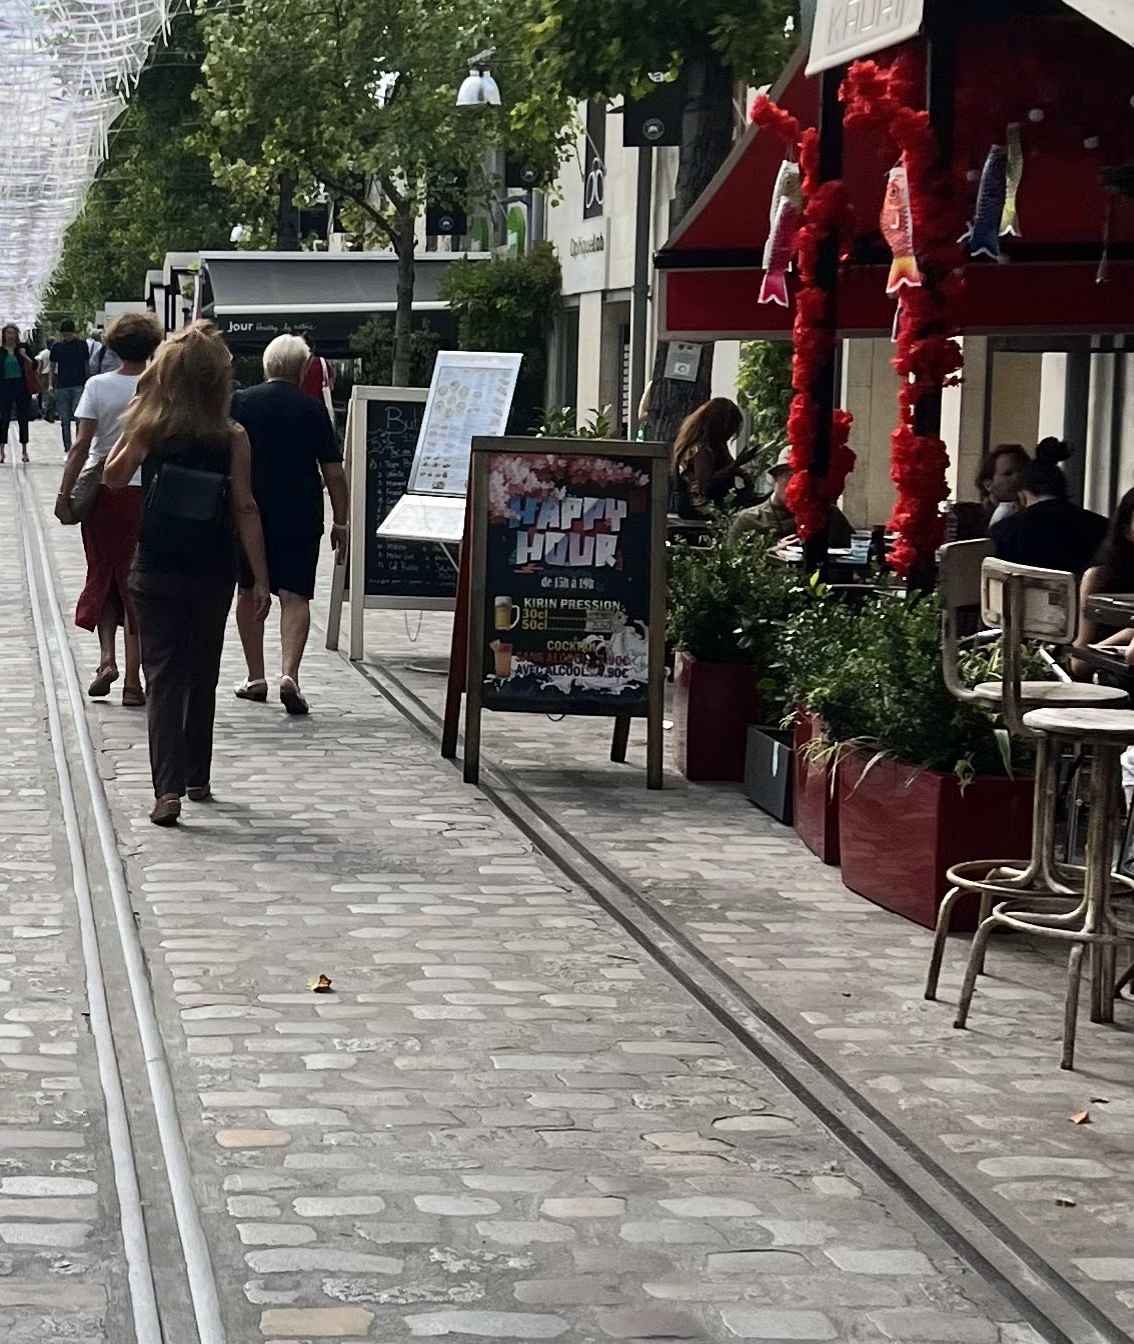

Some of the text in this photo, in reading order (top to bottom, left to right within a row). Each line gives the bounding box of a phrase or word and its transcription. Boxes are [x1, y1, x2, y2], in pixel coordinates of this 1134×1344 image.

[507, 497, 627, 531] HAPPY
[516, 531, 618, 567] HOUR
[541, 576, 553, 588] de
[523, 598, 621, 611] KIRIN PRESSION
